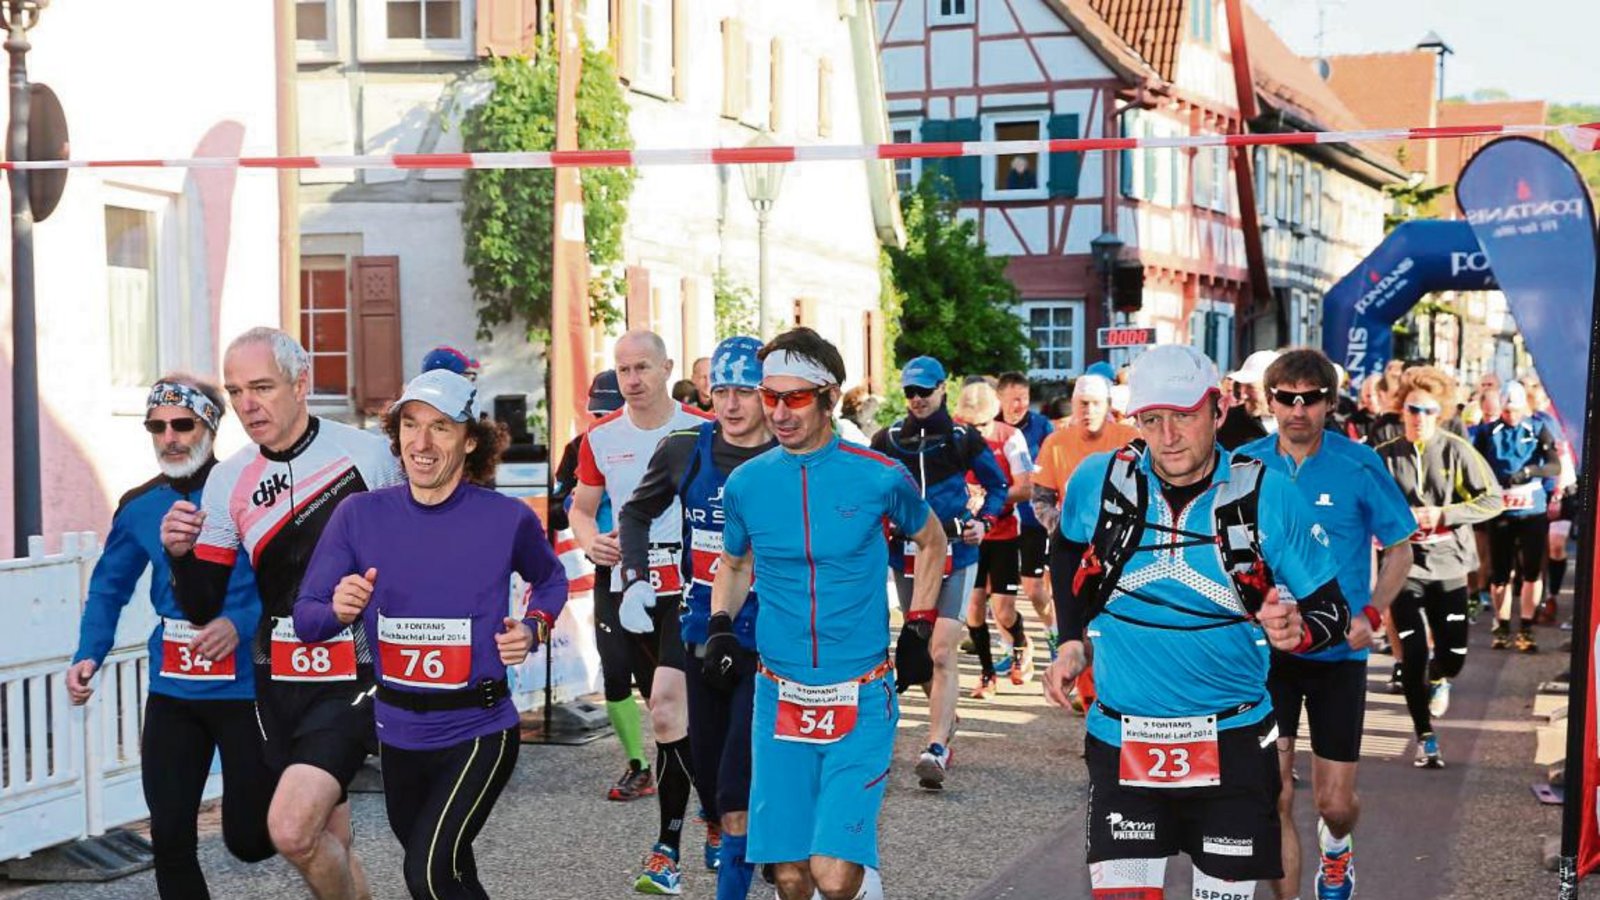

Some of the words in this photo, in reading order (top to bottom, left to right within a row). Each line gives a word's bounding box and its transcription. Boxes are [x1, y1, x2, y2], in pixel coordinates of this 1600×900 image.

[252, 473, 290, 508] djk
[178, 646, 212, 672] 34
[291, 646, 331, 673] 68
[400, 649, 444, 679] 76
[800, 709, 835, 736] 54
[1151, 721, 1192, 729] FONTANIS
[1193, 730, 1213, 738] 2014
[1148, 748, 1190, 777] 23
